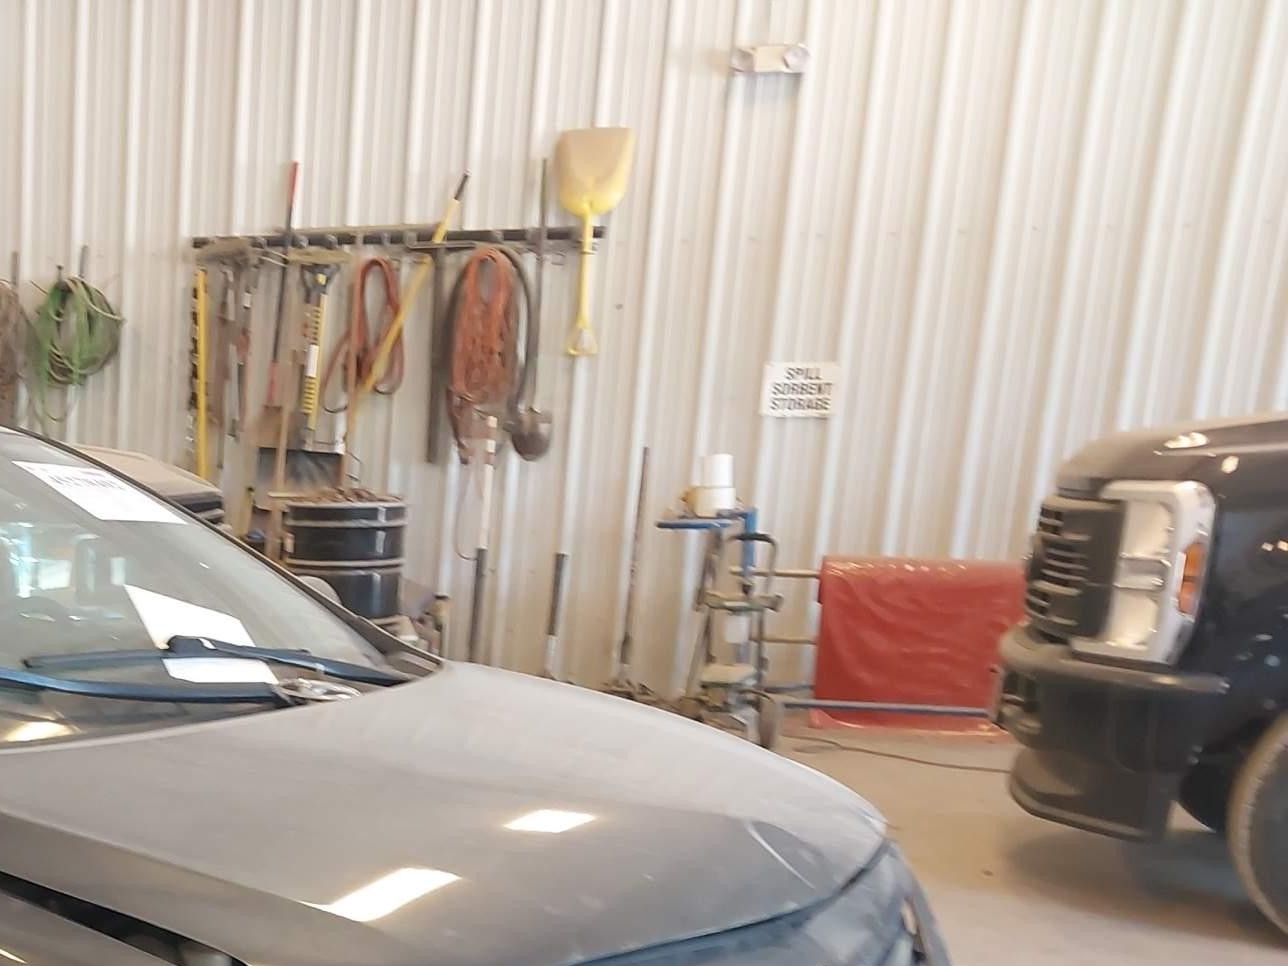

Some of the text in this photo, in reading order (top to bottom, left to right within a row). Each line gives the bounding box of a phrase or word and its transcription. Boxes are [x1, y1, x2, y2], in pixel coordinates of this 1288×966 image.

[785, 367, 822, 380] SPILL
[772, 382, 833, 395] SORBENT
[770, 397, 831, 410] STORAGE
